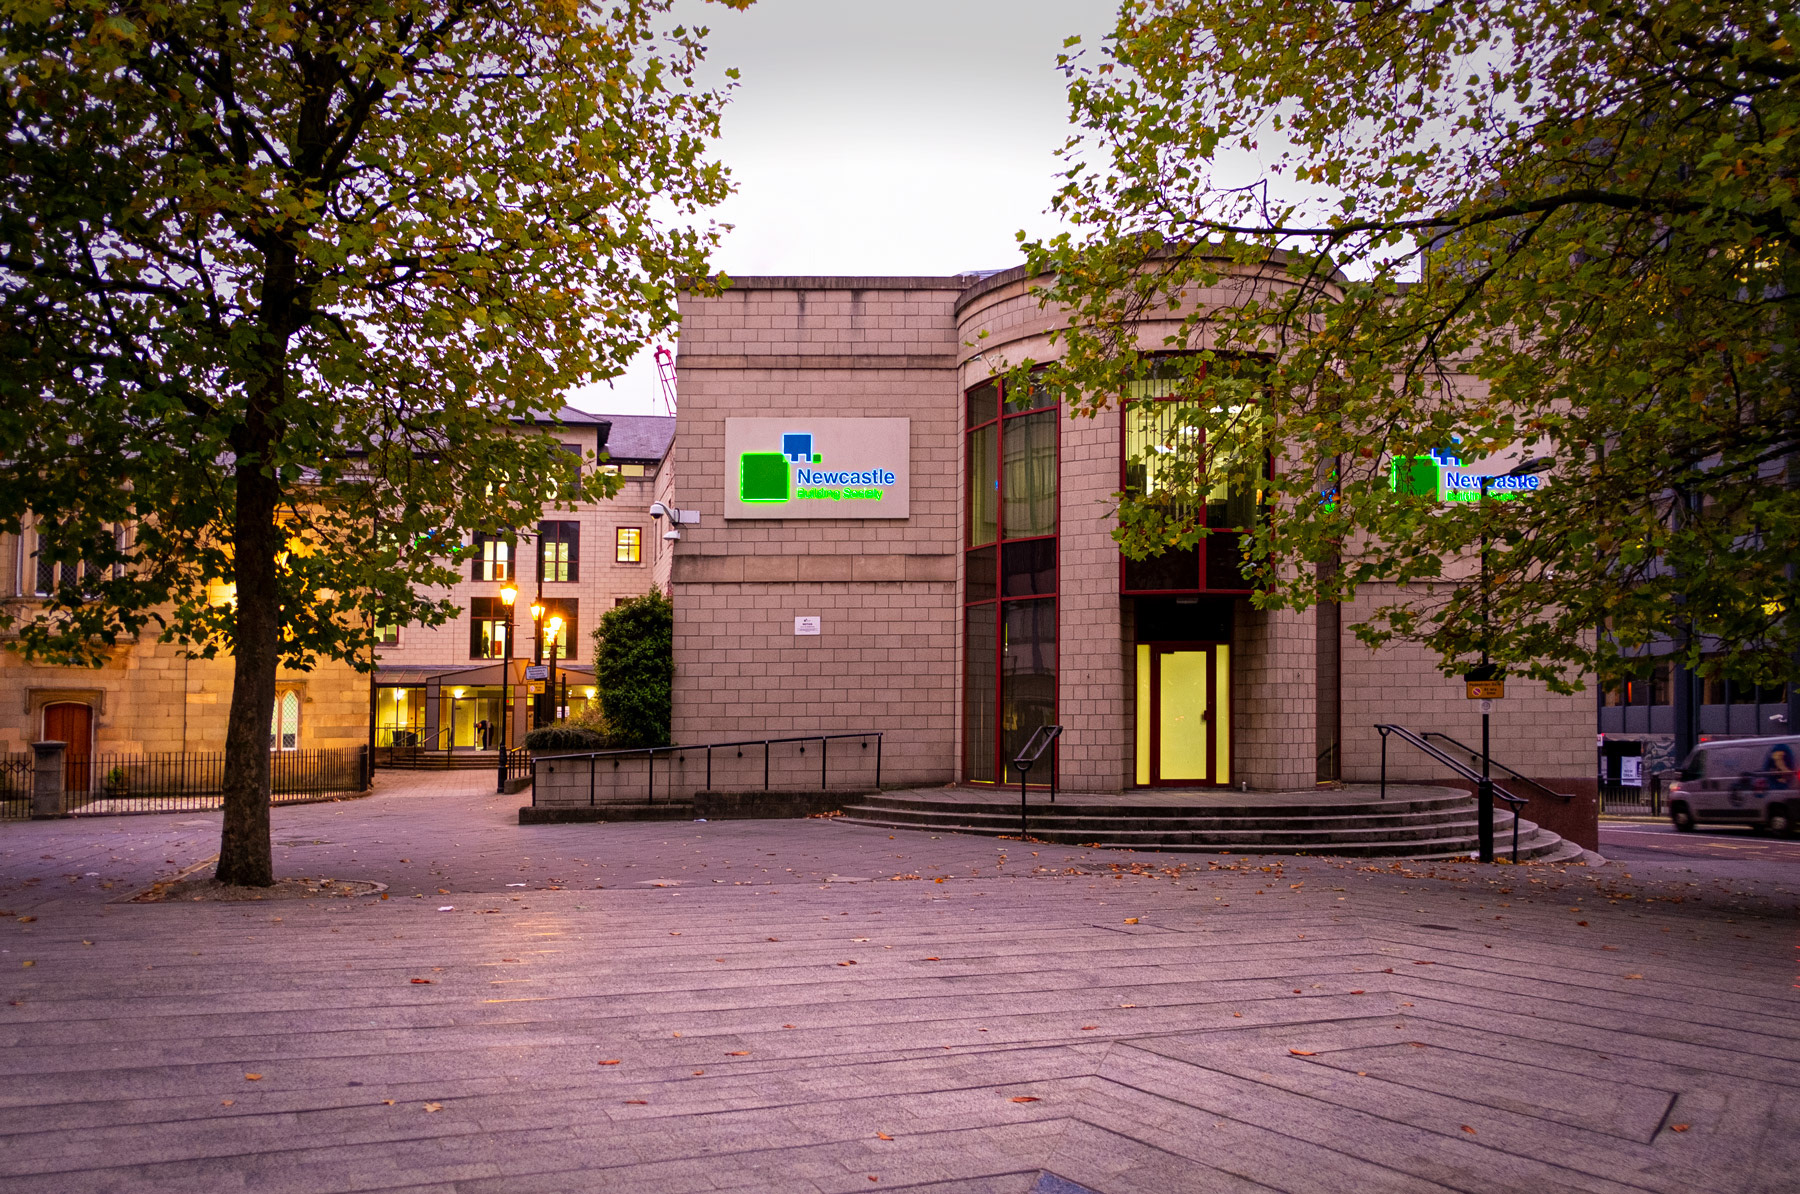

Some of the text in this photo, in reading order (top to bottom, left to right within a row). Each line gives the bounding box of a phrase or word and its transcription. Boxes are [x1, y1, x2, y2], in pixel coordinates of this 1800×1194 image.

[797, 468, 895, 485] Newcastle
[797, 487, 883, 501] Building Society
[1445, 490, 1482, 502] Buildin
